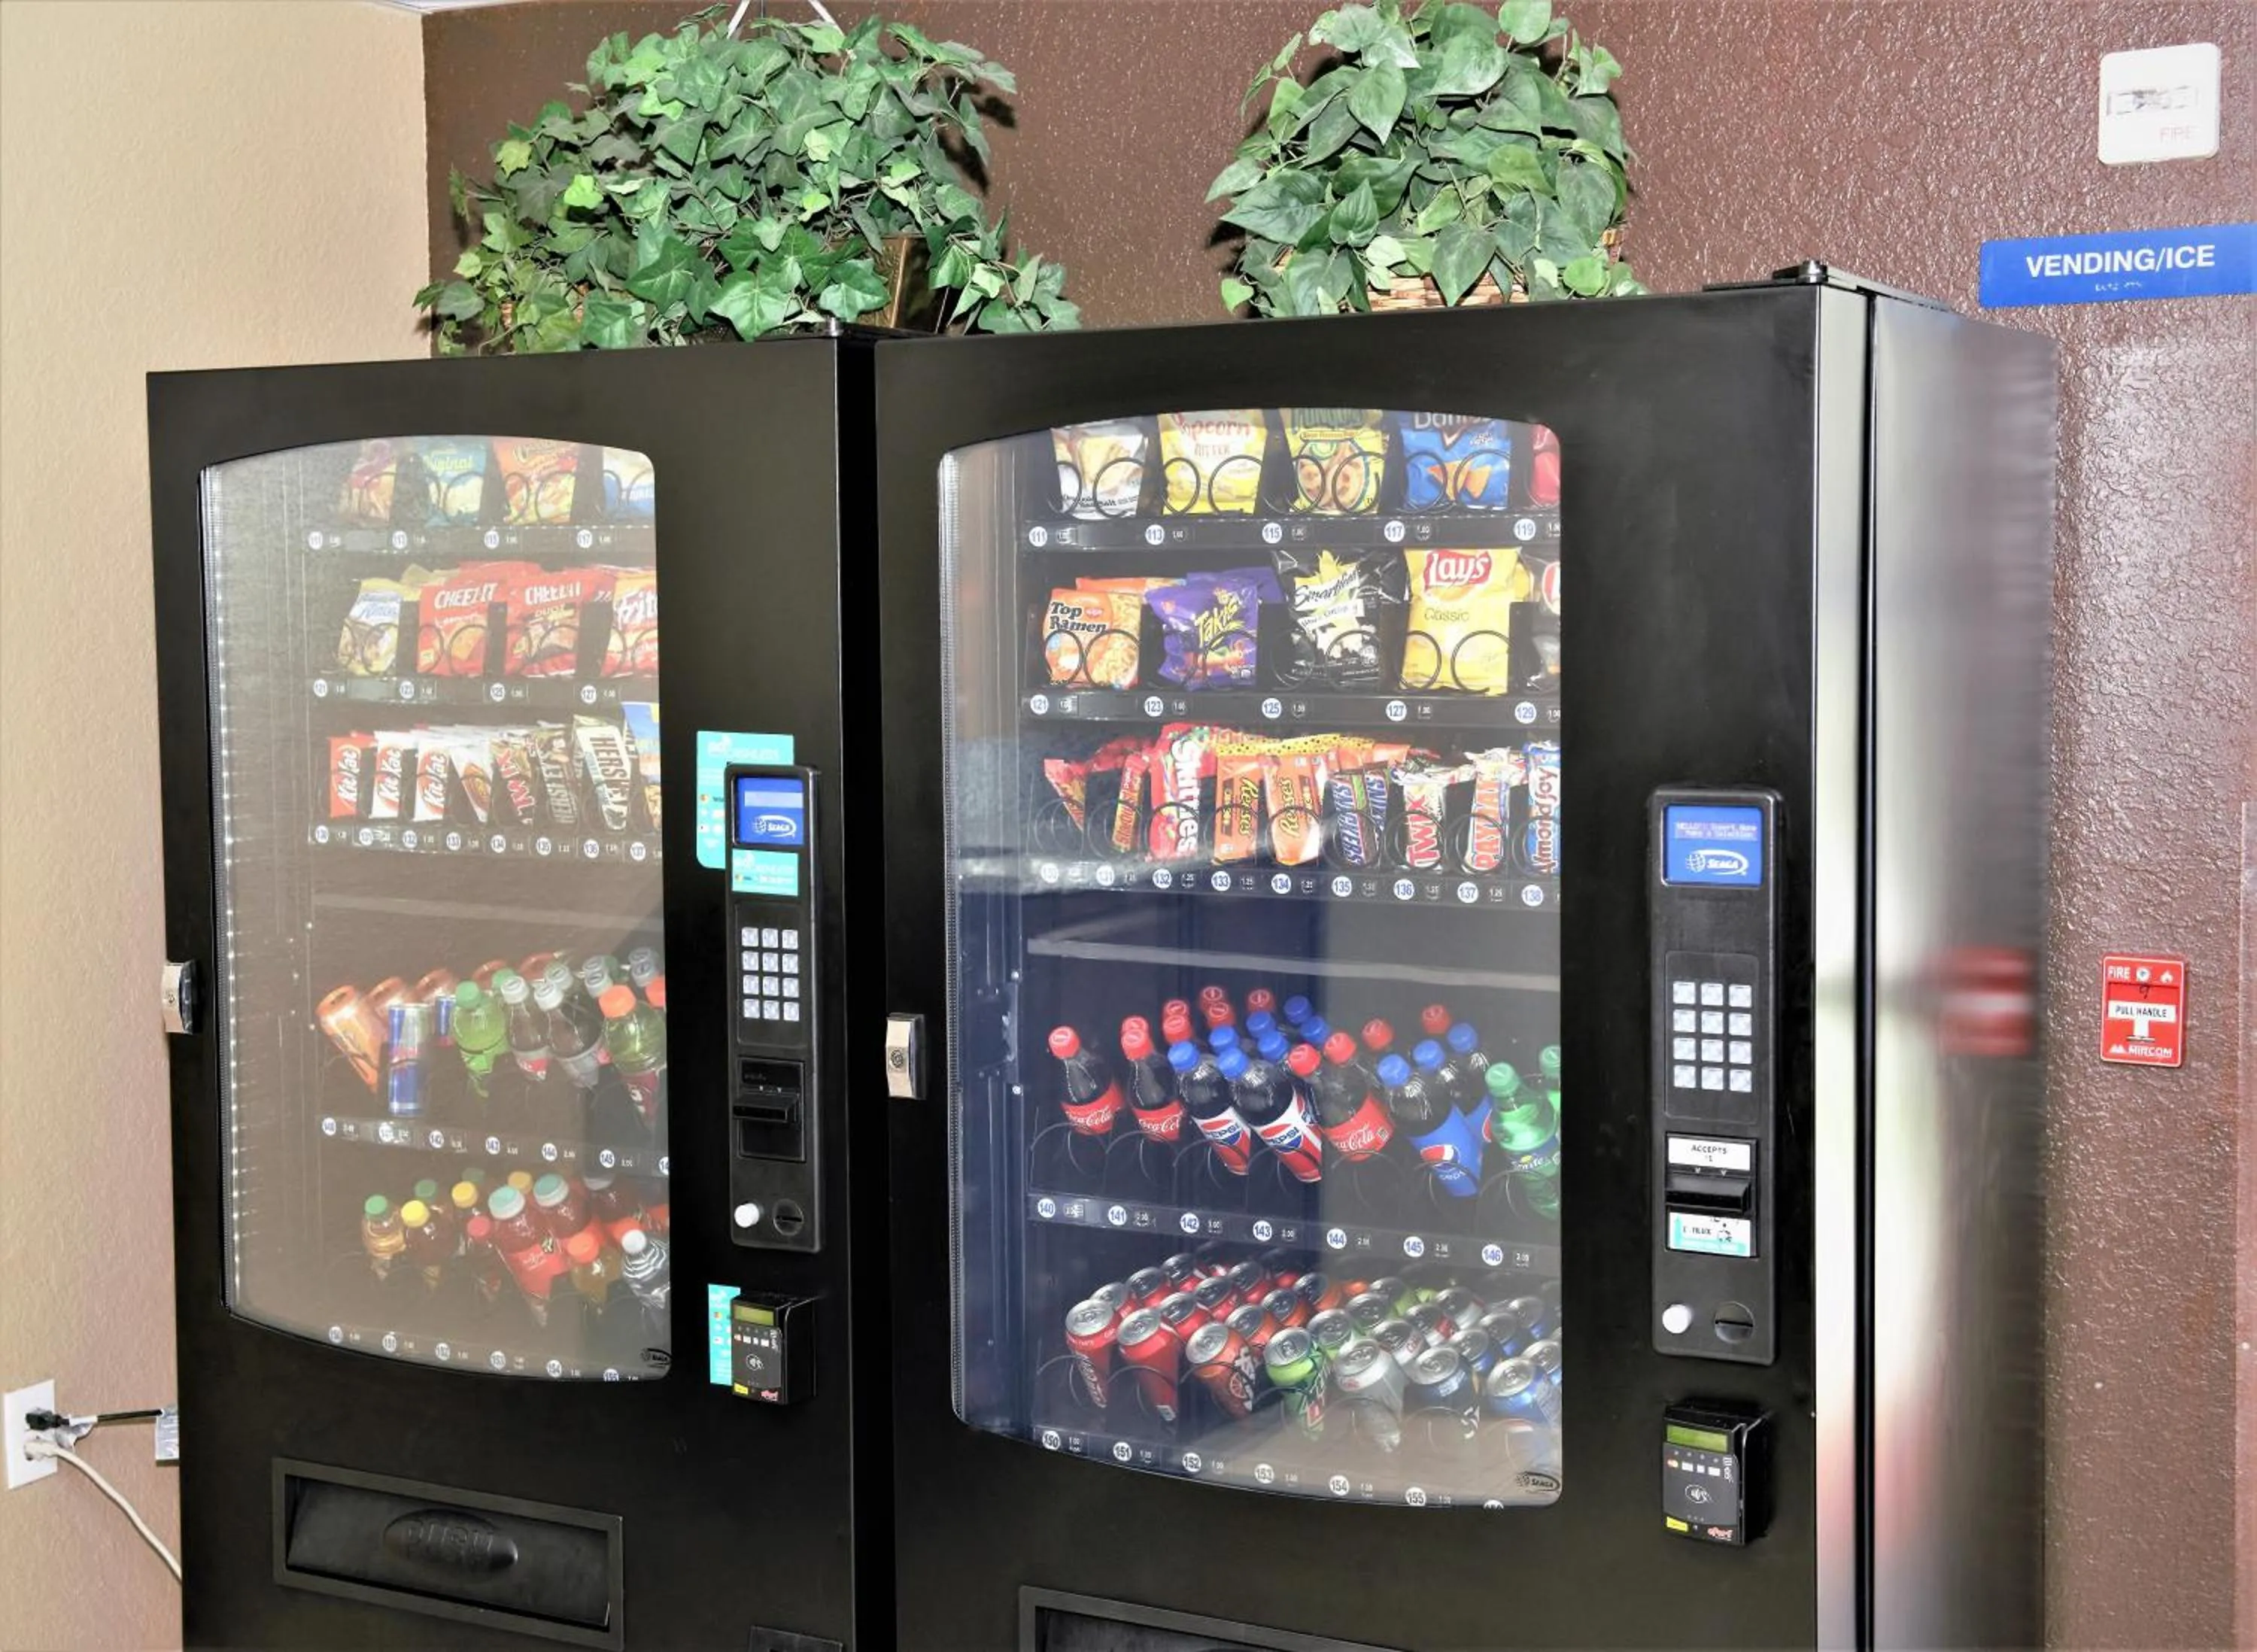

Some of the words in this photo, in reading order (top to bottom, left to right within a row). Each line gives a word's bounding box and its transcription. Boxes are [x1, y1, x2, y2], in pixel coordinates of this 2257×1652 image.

[2026, 244, 2215, 278] VENDING/ICE
[1265, 527, 1280, 540] 115
[1386, 526, 1403, 538] 117
[1516, 524, 1534, 536] 119
[1051, 602, 1082, 618] Top
[1424, 608, 1469, 622] Classic
[1050, 615, 1106, 633] Ramen
[1195, 600, 1240, 648] Takis
[1032, 700, 1048, 711] 121
[1146, 700, 1162, 712] 123
[1264, 703, 1280, 715] 125
[1387, 705, 1404, 716] 127
[1517, 707, 1535, 719] 129
[339, 749, 360, 774] Kat
[381, 746, 402, 775] Kat
[427, 751, 448, 781] Kat
[338, 773, 357, 802] Kit
[378, 774, 399, 801] Kit
[424, 779, 445, 809] Kit
[1171, 740, 1200, 857] Skittles
[1405, 794, 1441, 866] TWIX
[1154, 873, 1171, 885] 132
[1213, 876, 1229, 887] 133
[1274, 879, 1291, 890] 134
[1334, 881, 1351, 893] 135
[1396, 884, 1413, 896] 136
[1459, 886, 1476, 898] 137
[1524, 890, 1542, 902] 138
[2107, 966, 2131, 979] FIRE
[2115, 1005, 2134, 1015] PULL
[2137, 1007, 2167, 1017] HANDLE
[1691, 1144, 1727, 1155] ACCEPTS
[601, 1154, 614, 1164] 145
[1039, 1203, 1054, 1214] 140
[1110, 1210, 1125, 1222] 141
[1182, 1217, 1198, 1229] 142
[1255, 1225, 1271, 1237] 143
[1329, 1234, 1345, 1246] 144
[1406, 1241, 1423, 1253] 145
[1484, 1250, 1502, 1262] 146
[1043, 1435, 1060, 1447] 150
[1115, 1446, 1131, 1458] 151
[1184, 1456, 1201, 1468] 152
[1256, 1468, 1273, 1480] 153
[1331, 1479, 1348, 1492] 154
[1408, 1492, 1425, 1505] 155
